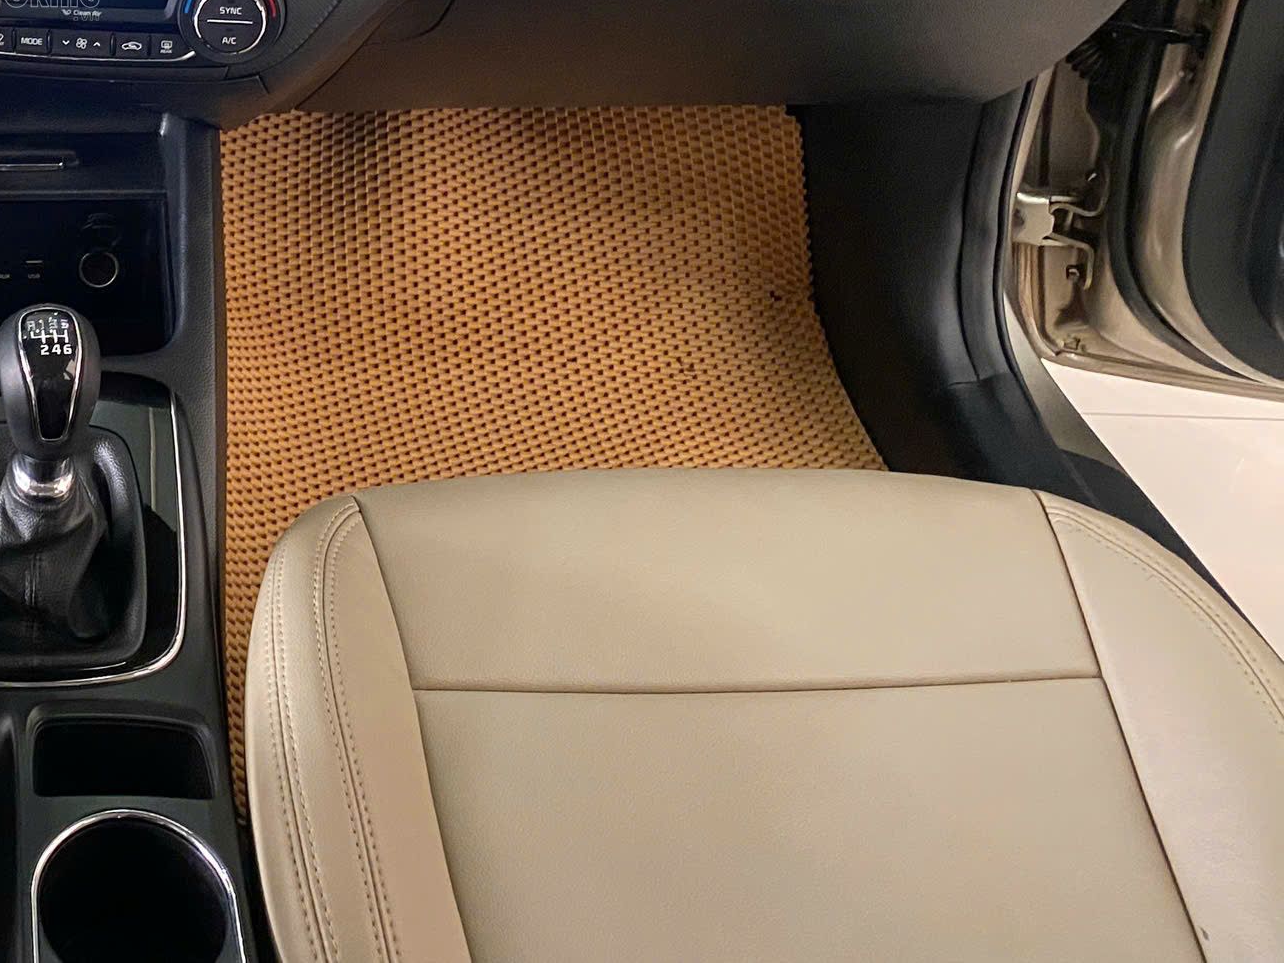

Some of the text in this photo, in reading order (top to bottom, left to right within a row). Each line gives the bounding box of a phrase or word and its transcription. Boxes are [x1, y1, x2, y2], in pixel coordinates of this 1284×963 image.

[219, 6, 242, 15] SYNC
[20, 36, 44, 46] MODE
[222, 37, 236, 45] A/C
